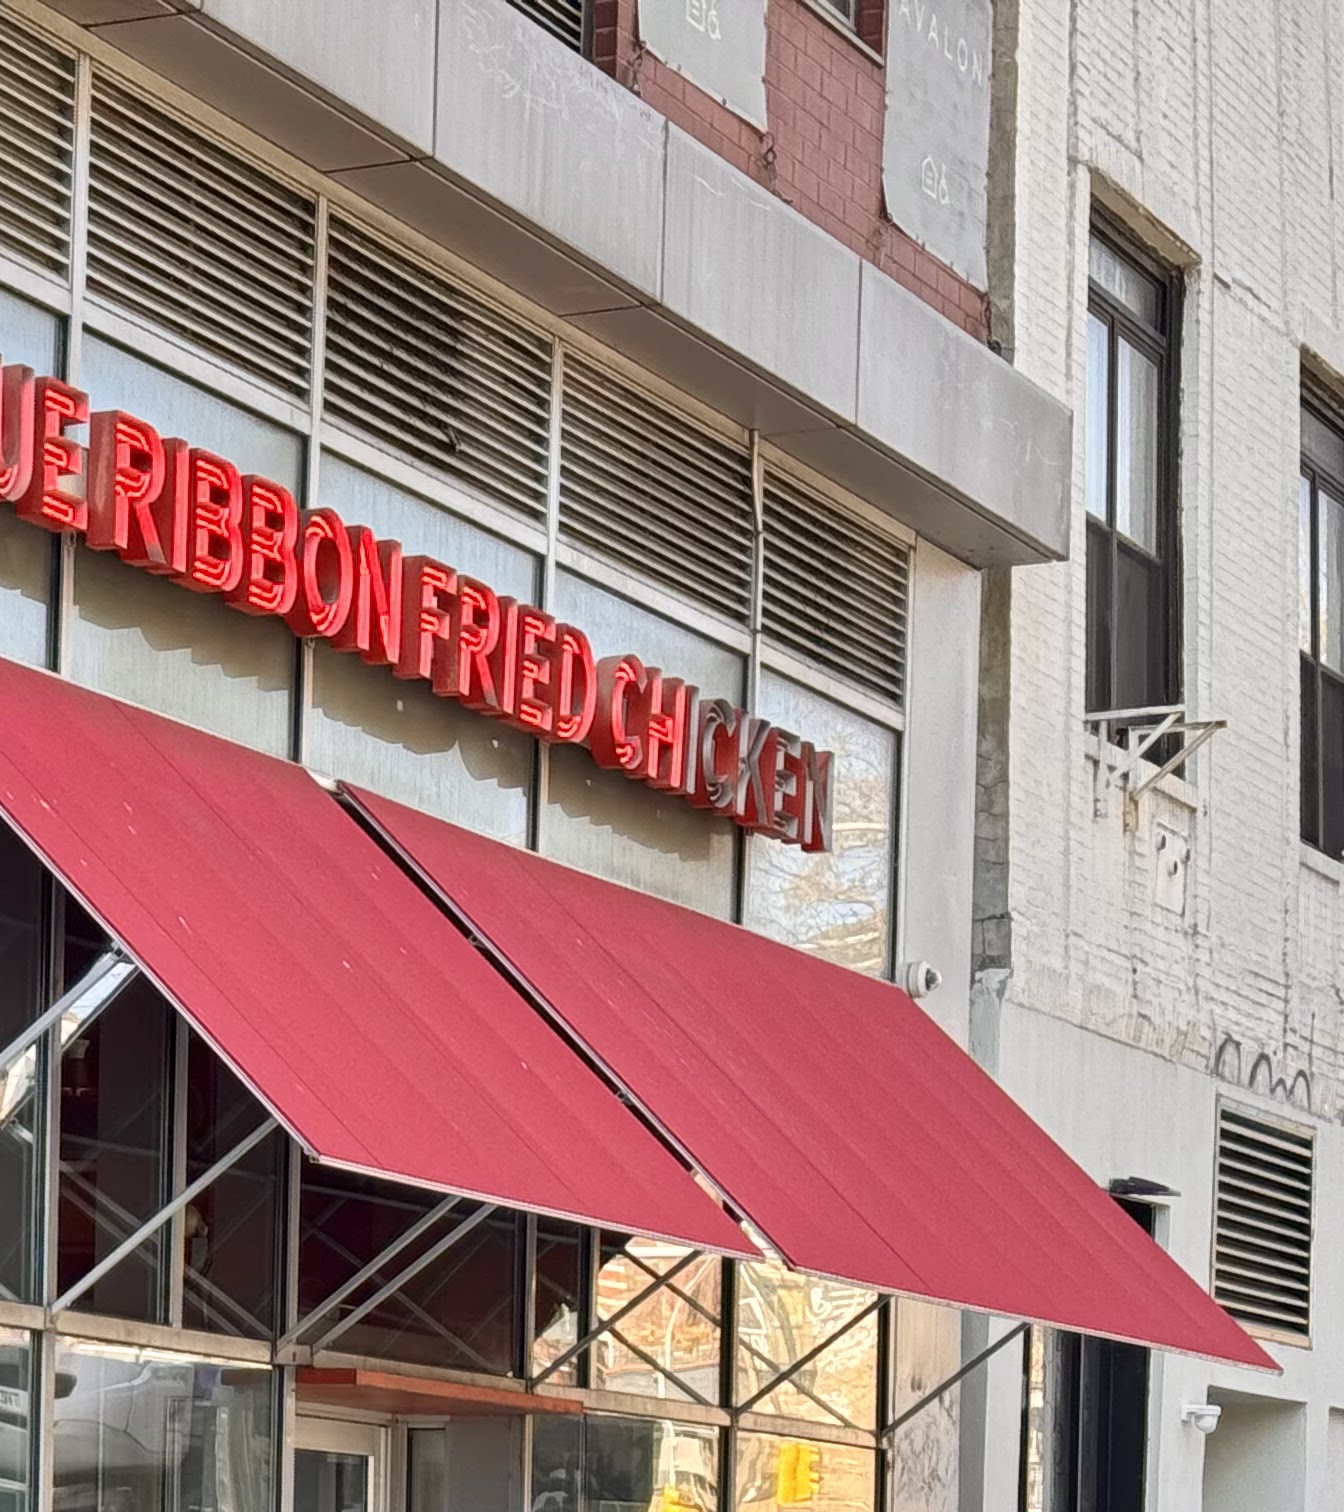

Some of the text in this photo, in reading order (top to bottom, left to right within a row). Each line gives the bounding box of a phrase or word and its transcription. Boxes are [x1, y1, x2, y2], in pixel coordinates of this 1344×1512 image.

[898, 0, 982, 88] AVALON
[87, 409, 404, 666] RIBBON
[394, 554, 597, 745] FRIED
[589, 653, 836, 853] CHICKEN
